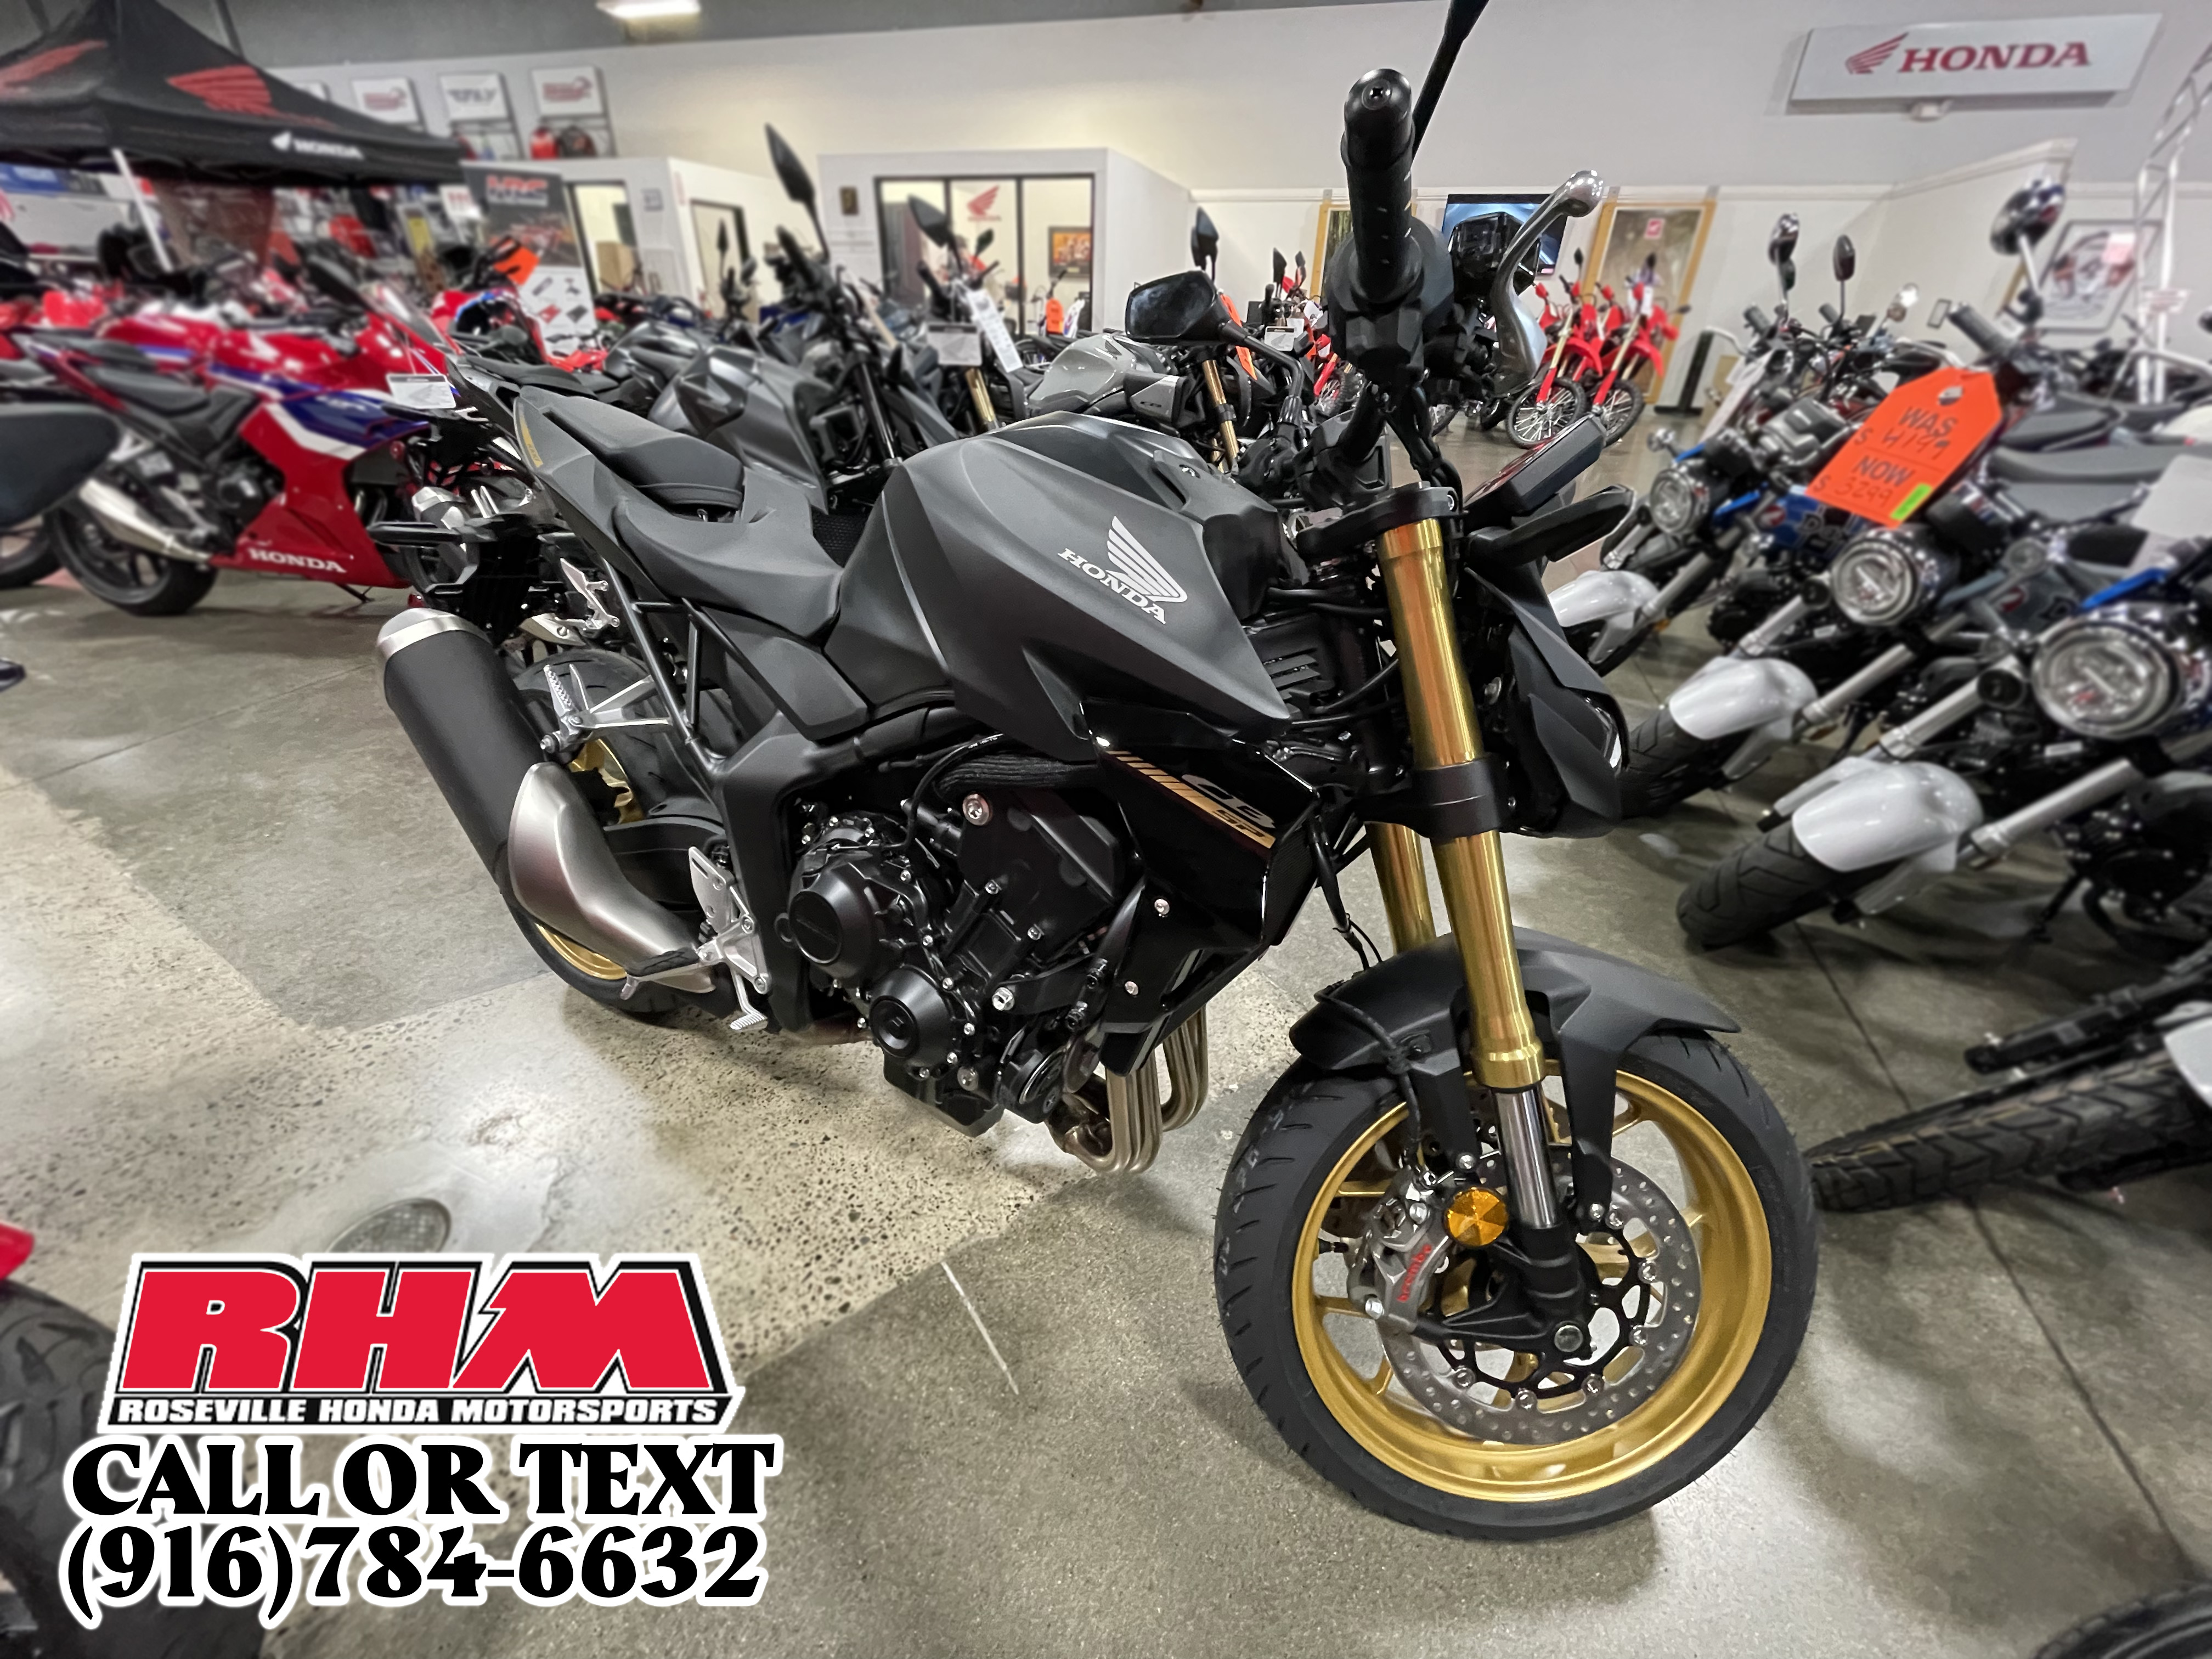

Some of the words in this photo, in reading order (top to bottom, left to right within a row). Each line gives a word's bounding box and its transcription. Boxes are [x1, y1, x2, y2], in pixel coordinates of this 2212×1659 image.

[1898, 41, 2092, 73] HONDA
[1898, 406, 1958, 439] WAS
[1851, 454, 1917, 487] NOW
[247, 547, 347, 574] HONDA
[1057, 548, 1166, 624] HONDA
[1181, 774, 1276, 830] CB
[1396, 1243, 1432, 1304] brembo
